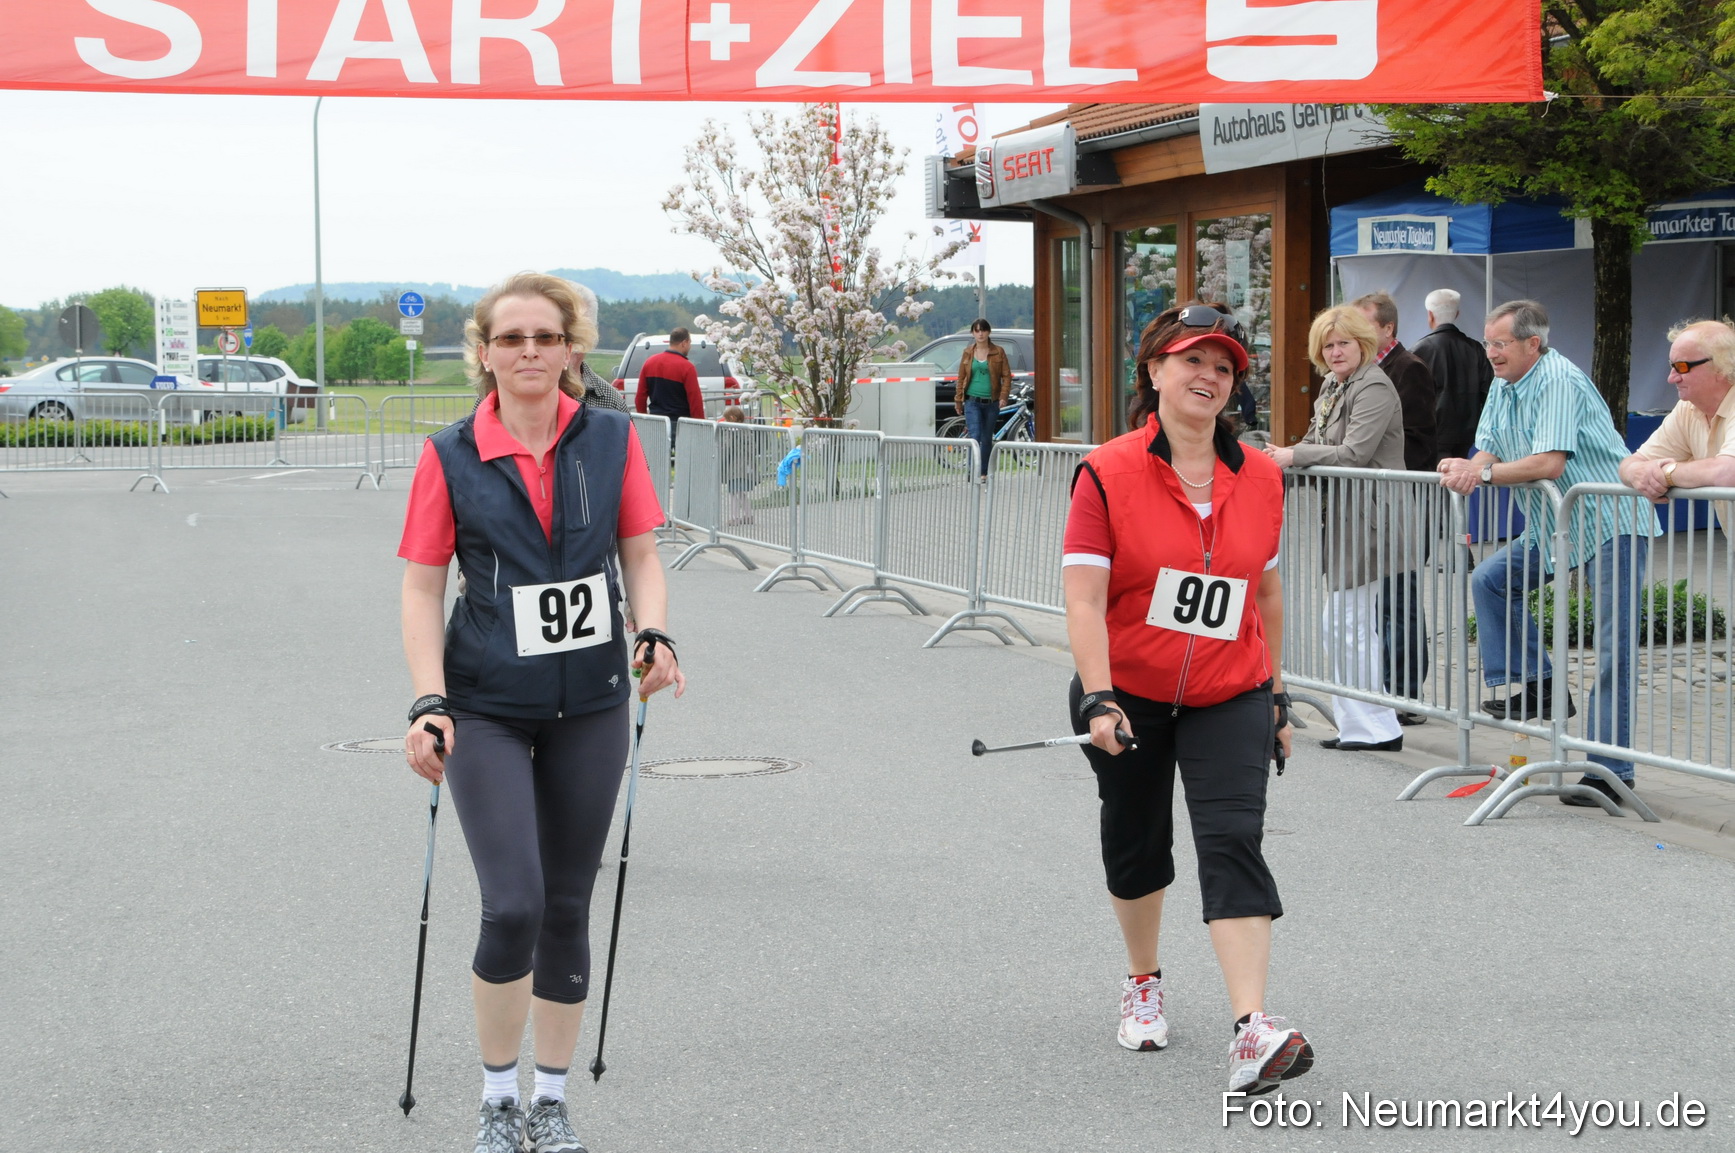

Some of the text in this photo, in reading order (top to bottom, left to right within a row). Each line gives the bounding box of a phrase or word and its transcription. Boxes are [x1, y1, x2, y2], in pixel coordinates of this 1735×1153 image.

[1213, 108, 1286, 146] Autohaus
[1003, 147, 1054, 181] SEAT
[1407, 226, 1434, 247] Tagblatt
[1638, 214, 1716, 235] umarkter
[202, 303, 242, 313] Neumarkt
[539, 583, 595, 643] 92
[1173, 576, 1231, 629] 90
